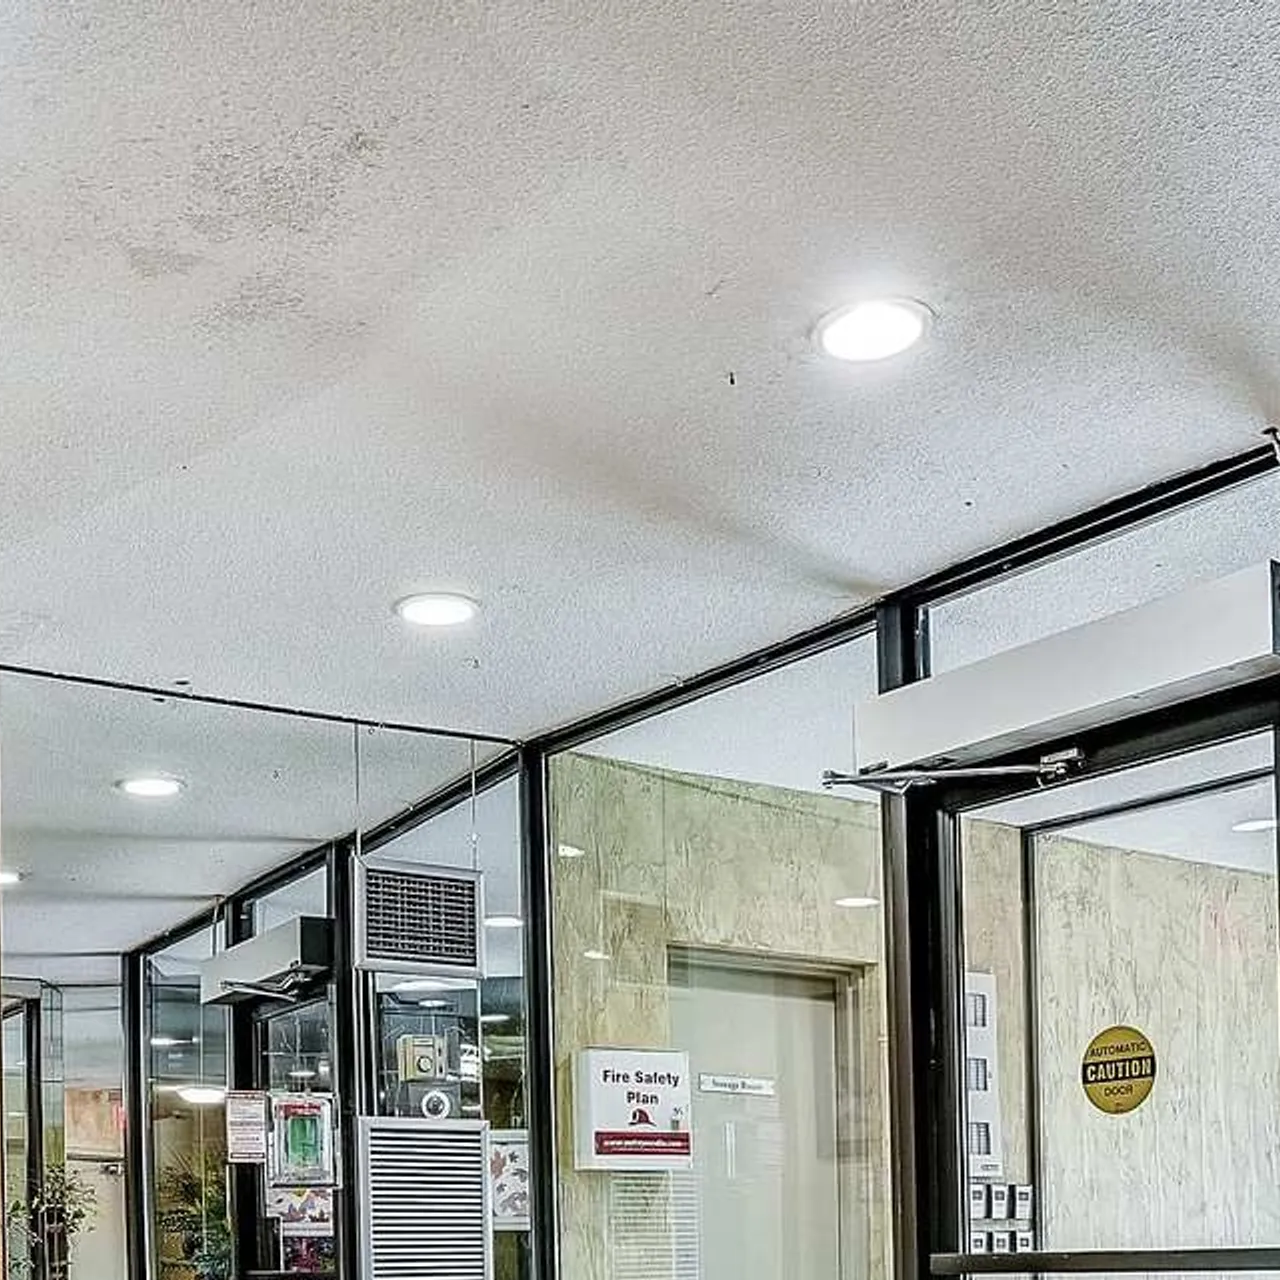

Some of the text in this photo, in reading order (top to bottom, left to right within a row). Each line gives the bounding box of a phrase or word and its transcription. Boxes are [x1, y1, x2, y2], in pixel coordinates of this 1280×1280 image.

[1091, 1042, 1146, 1057] AUTOMATIC
[1086, 1058, 1152, 1082] CAUTION
[602, 1069, 681, 1088] Fire Safety
[1104, 1084, 1134, 1097] DOOR
[627, 1092, 660, 1105] Plan
